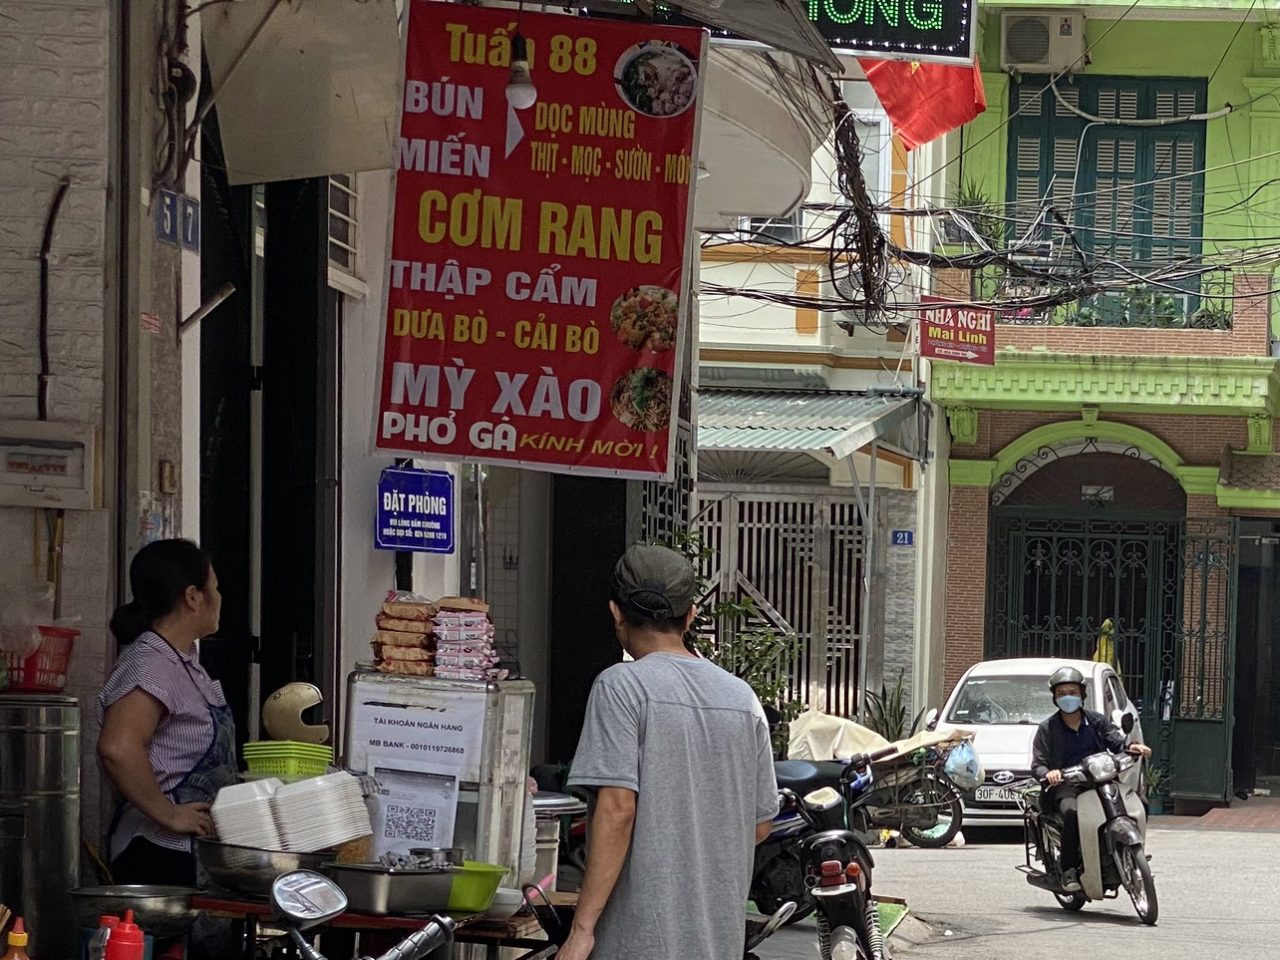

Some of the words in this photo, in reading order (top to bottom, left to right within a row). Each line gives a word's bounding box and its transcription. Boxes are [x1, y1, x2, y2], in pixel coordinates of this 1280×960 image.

[549, 34, 597, 75] 88
[405, 76, 484, 120] BÚN
[535, 102, 573, 139] DỌC
[579, 102, 635, 139] MÙNG
[400, 132, 491, 178] MIẾN
[531, 142, 559, 179] THỊT
[571, 145, 602, 182] MỌC
[615, 144, 651, 181] SƯỜN
[418, 189, 523, 251] CƠM
[538, 201, 663, 264] RANG
[390, 259, 492, 300] THẬP
[505, 264, 597, 307] CẨM
[393, 308, 445, 340] DƯA
[453, 313, 488, 344] BÒ
[514, 312, 557, 350] CẢI
[565, 319, 600, 355] BÒ
[928, 326, 954, 341] Mai
[958, 330, 987, 345] Linh
[390, 358, 476, 411] MỲ
[491, 366, 602, 423] XÀO
[382, 410, 457, 445] PHỞ
[520, 432, 584, 453] KÍNH
[591, 439, 643, 458] MỜI
[384, 489, 406, 515] ĐẶT
[408, 491, 447, 515] PHÒNG
[896, 532, 909, 544] 21
[369, 739, 381, 747] MB
[383, 740, 405, 749] BANK
